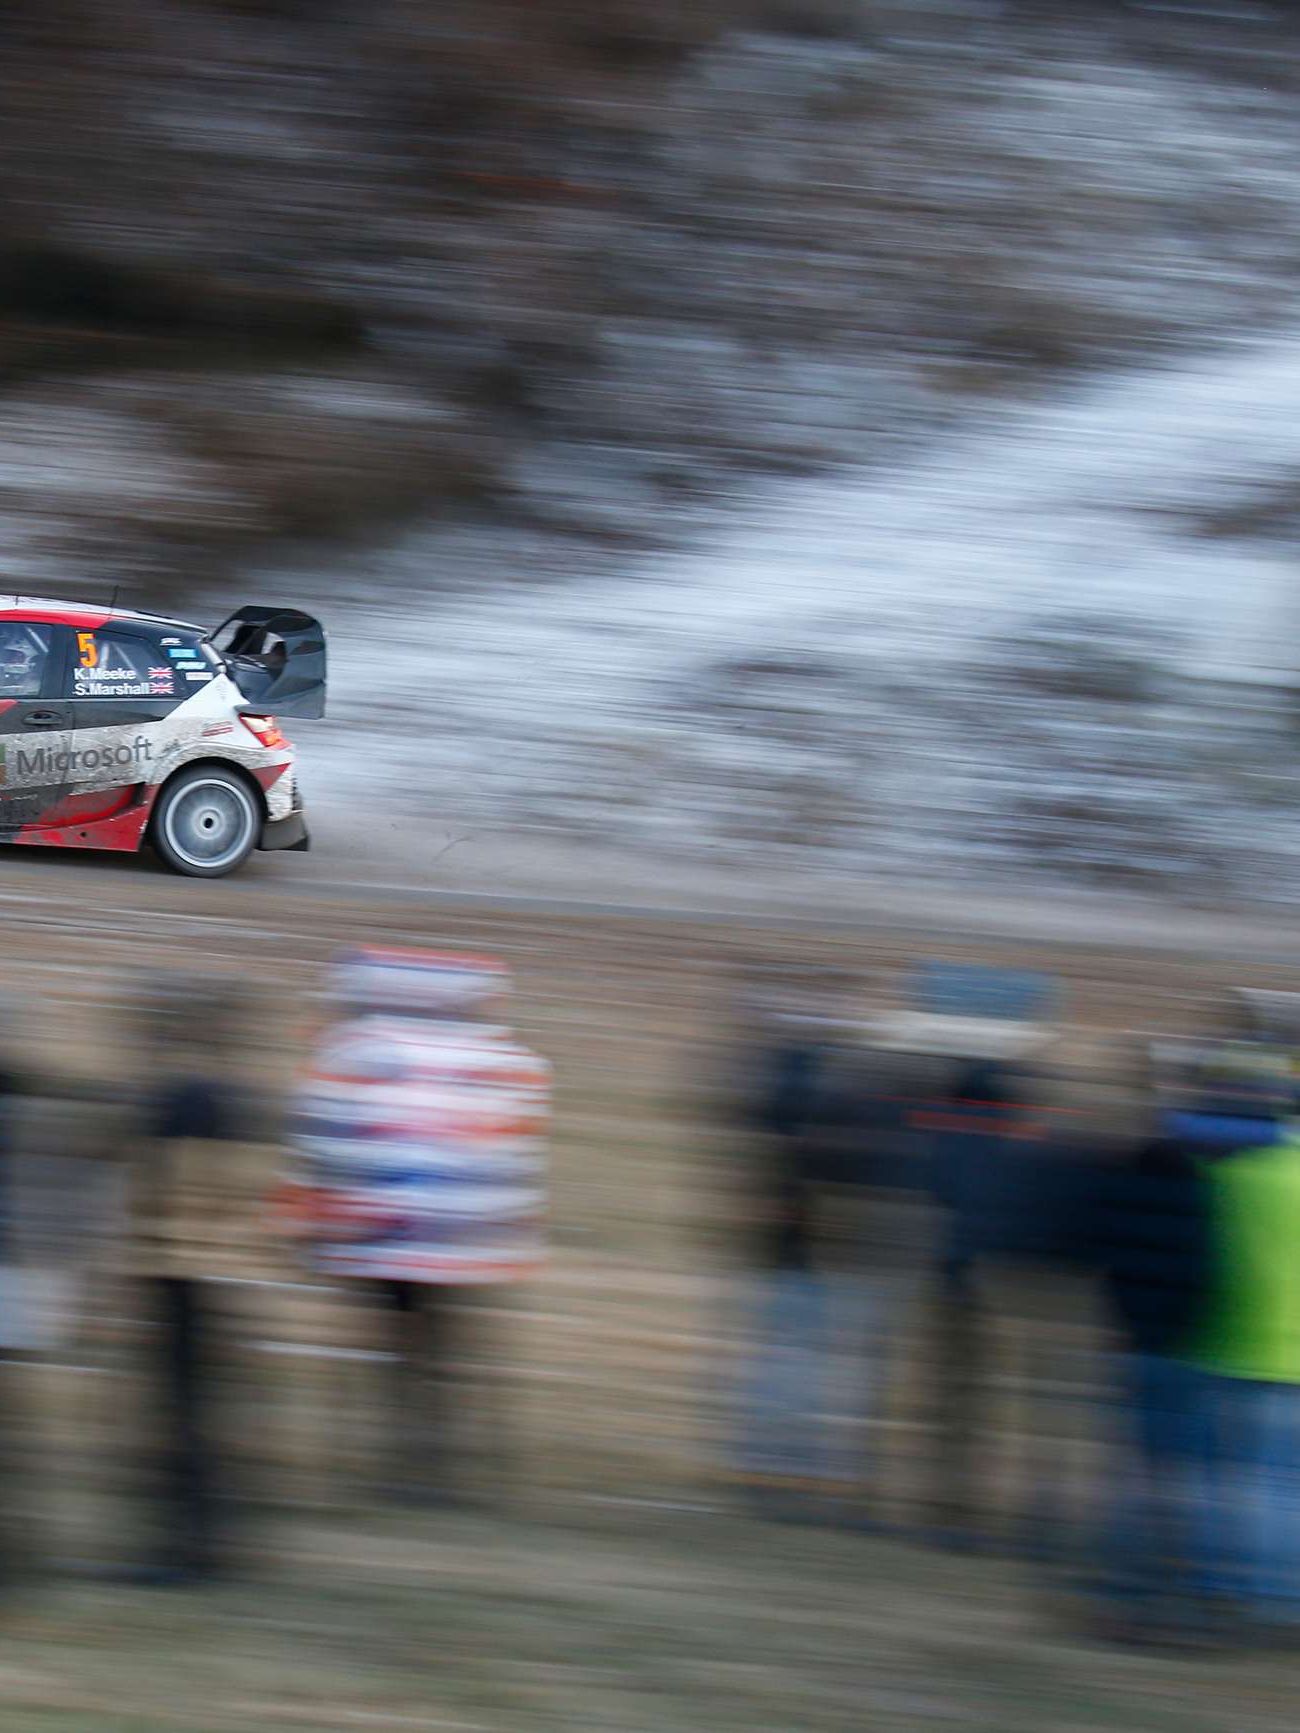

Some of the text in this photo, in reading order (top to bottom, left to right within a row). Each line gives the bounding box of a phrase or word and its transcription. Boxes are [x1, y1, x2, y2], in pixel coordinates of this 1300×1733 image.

[77, 633, 98, 667] 5
[74, 668, 136, 680] K.Meeke
[74, 683, 150, 696] S.Marshall
[17, 735, 153, 776] Microsoft
